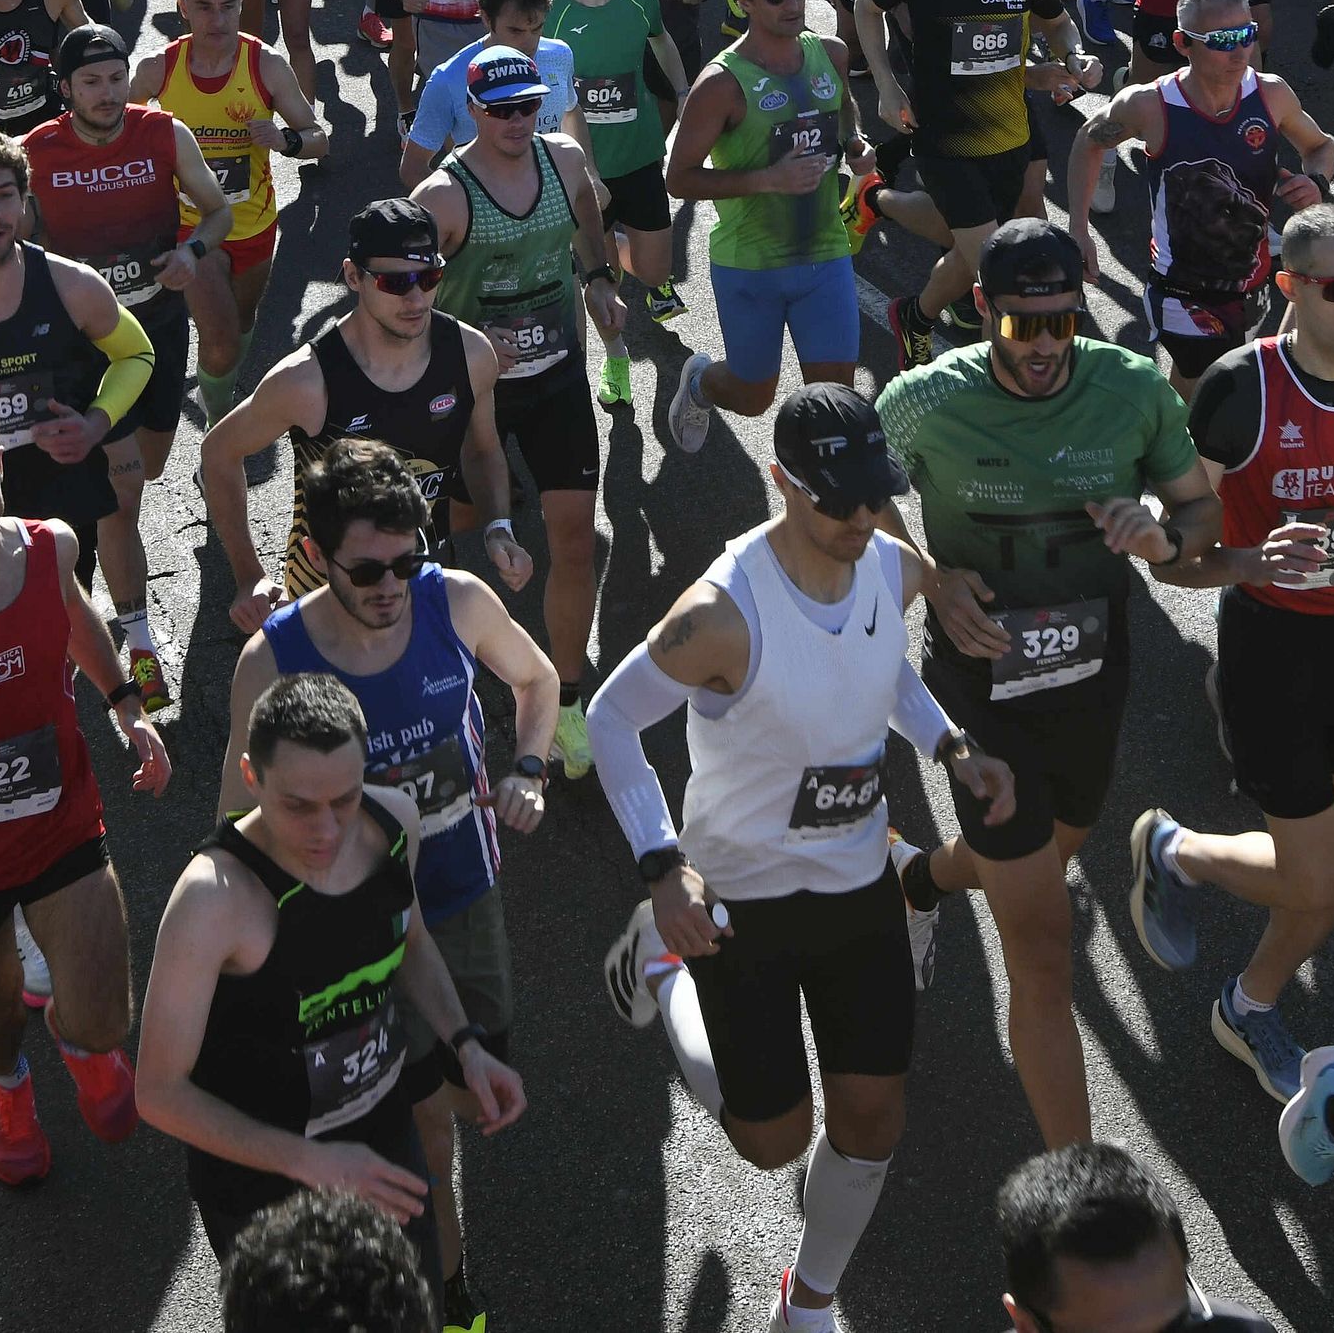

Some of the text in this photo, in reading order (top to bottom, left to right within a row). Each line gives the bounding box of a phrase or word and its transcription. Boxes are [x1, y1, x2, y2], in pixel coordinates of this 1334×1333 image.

[956, 24, 964, 34] A
[972, 32, 1009, 52] 666
[7, 83, 34, 100] 416
[586, 86, 623, 104] 604
[774, 127, 782, 137] A
[51, 158, 156, 189] BUCCI
[86, 173, 156, 194] INDUSTRIES
[99, 260, 142, 283] 760
[0, 353, 38, 370] SPORT
[1022, 624, 1081, 659] 329
[400, 717, 435, 748] pub
[314, 1051, 326, 1067] A
